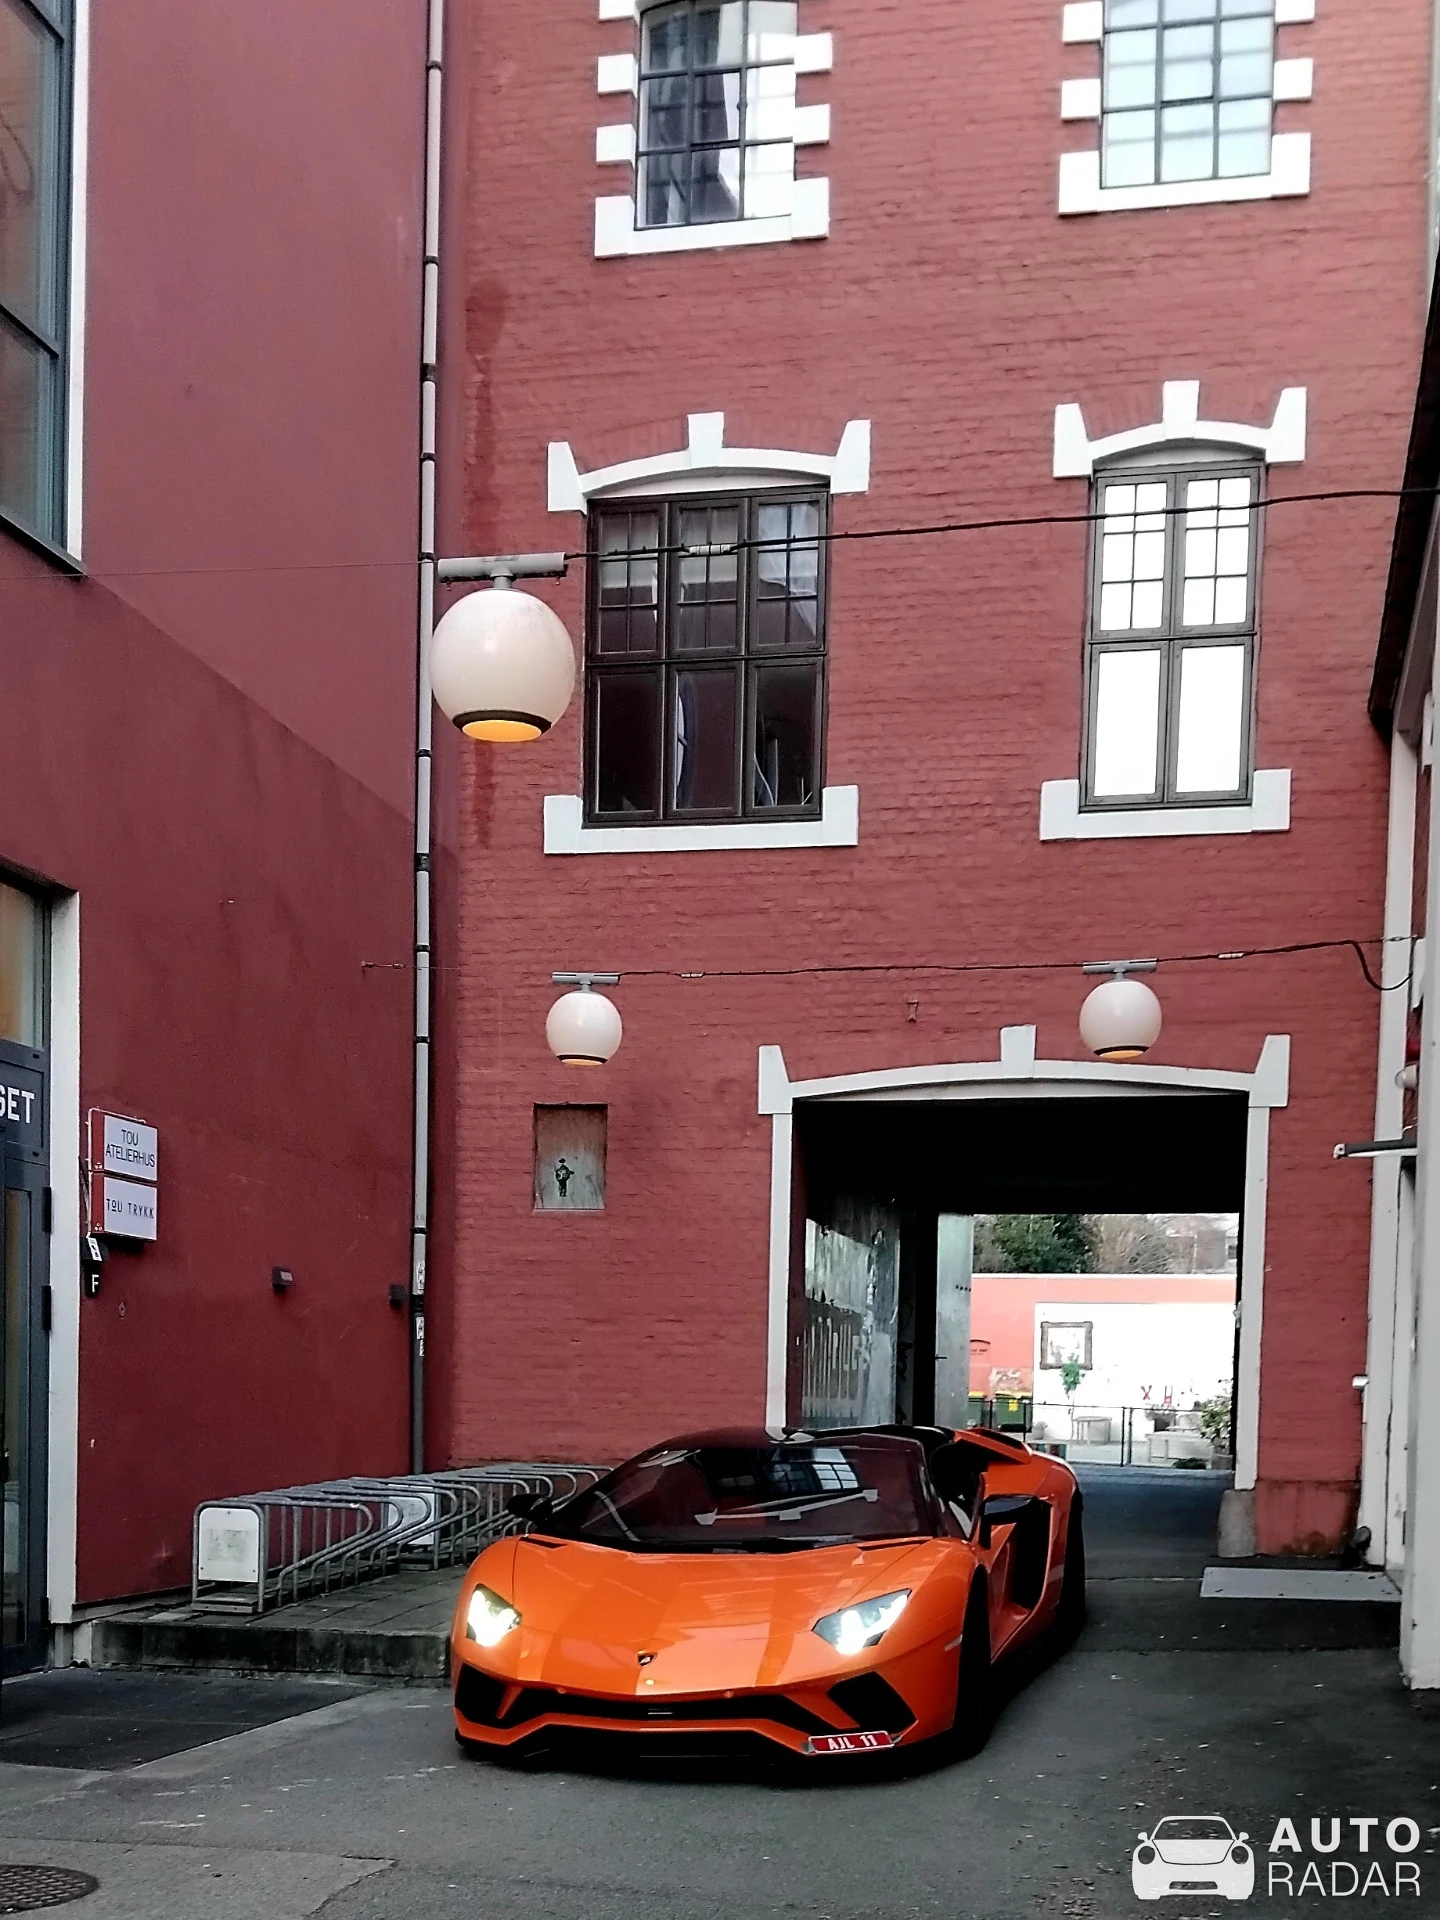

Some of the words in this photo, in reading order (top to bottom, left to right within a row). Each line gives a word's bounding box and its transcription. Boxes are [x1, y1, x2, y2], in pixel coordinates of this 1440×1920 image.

[121, 1129, 139, 1146] TOU
[105, 1143, 155, 1168] ATELIERHUS
[106, 1198, 123, 1213] TOU
[127, 1202, 155, 1219] TRYKK
[91, 1274, 100, 1293] F
[828, 1737, 855, 1750] AJL
[859, 1734, 878, 1747] 11
